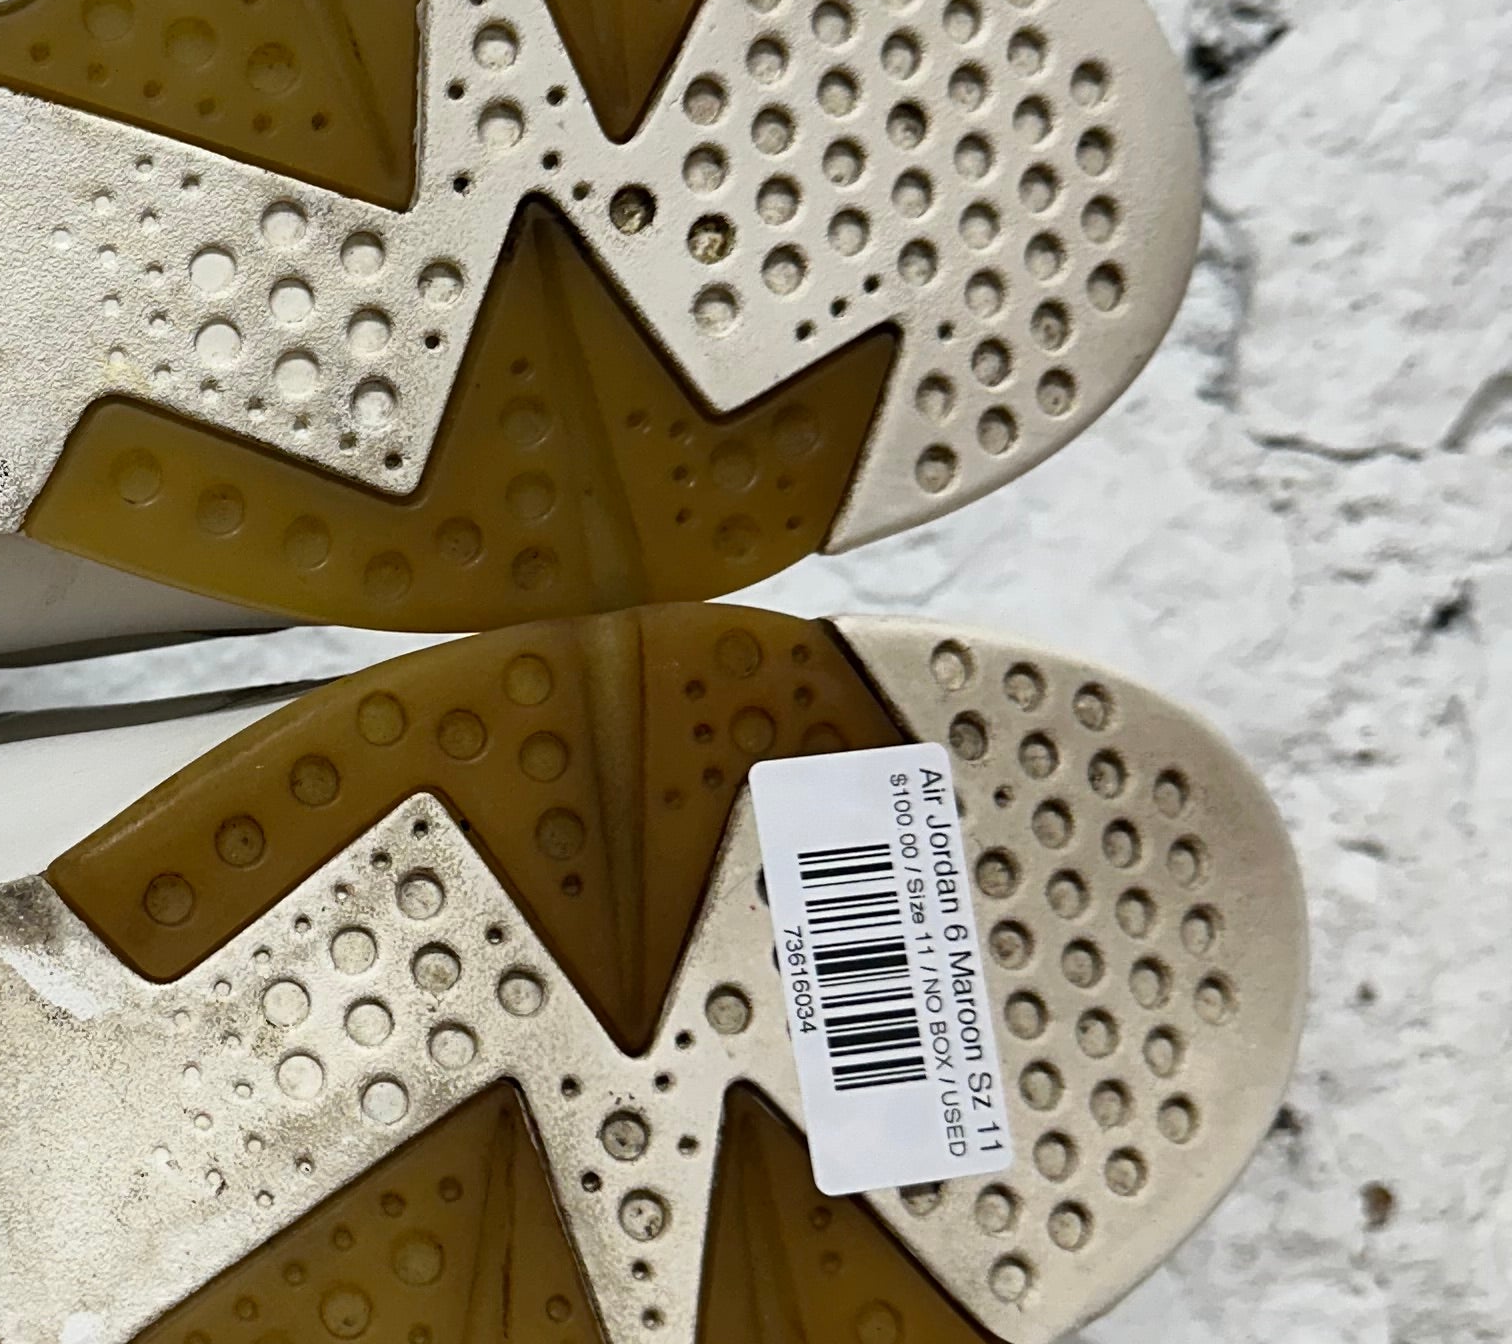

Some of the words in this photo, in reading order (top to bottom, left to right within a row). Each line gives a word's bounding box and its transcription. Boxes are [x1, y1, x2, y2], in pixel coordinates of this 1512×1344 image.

[919, 768, 946, 805] Air
[889, 773, 919, 859] $100.00
[925, 814, 959, 914] Jordan
[906, 878, 926, 924] Size
[915, 932, 935, 955] 11
[943, 923, 969, 942] 6
[783, 925, 818, 1035] 73616034
[922, 978, 943, 1014] NO
[948, 950, 983, 1061] Maroon
[929, 1020, 954, 1070] BOX
[967, 1071, 993, 1110] Sz
[941, 1090, 967, 1157] USED
[977, 1121, 1004, 1151] 11
